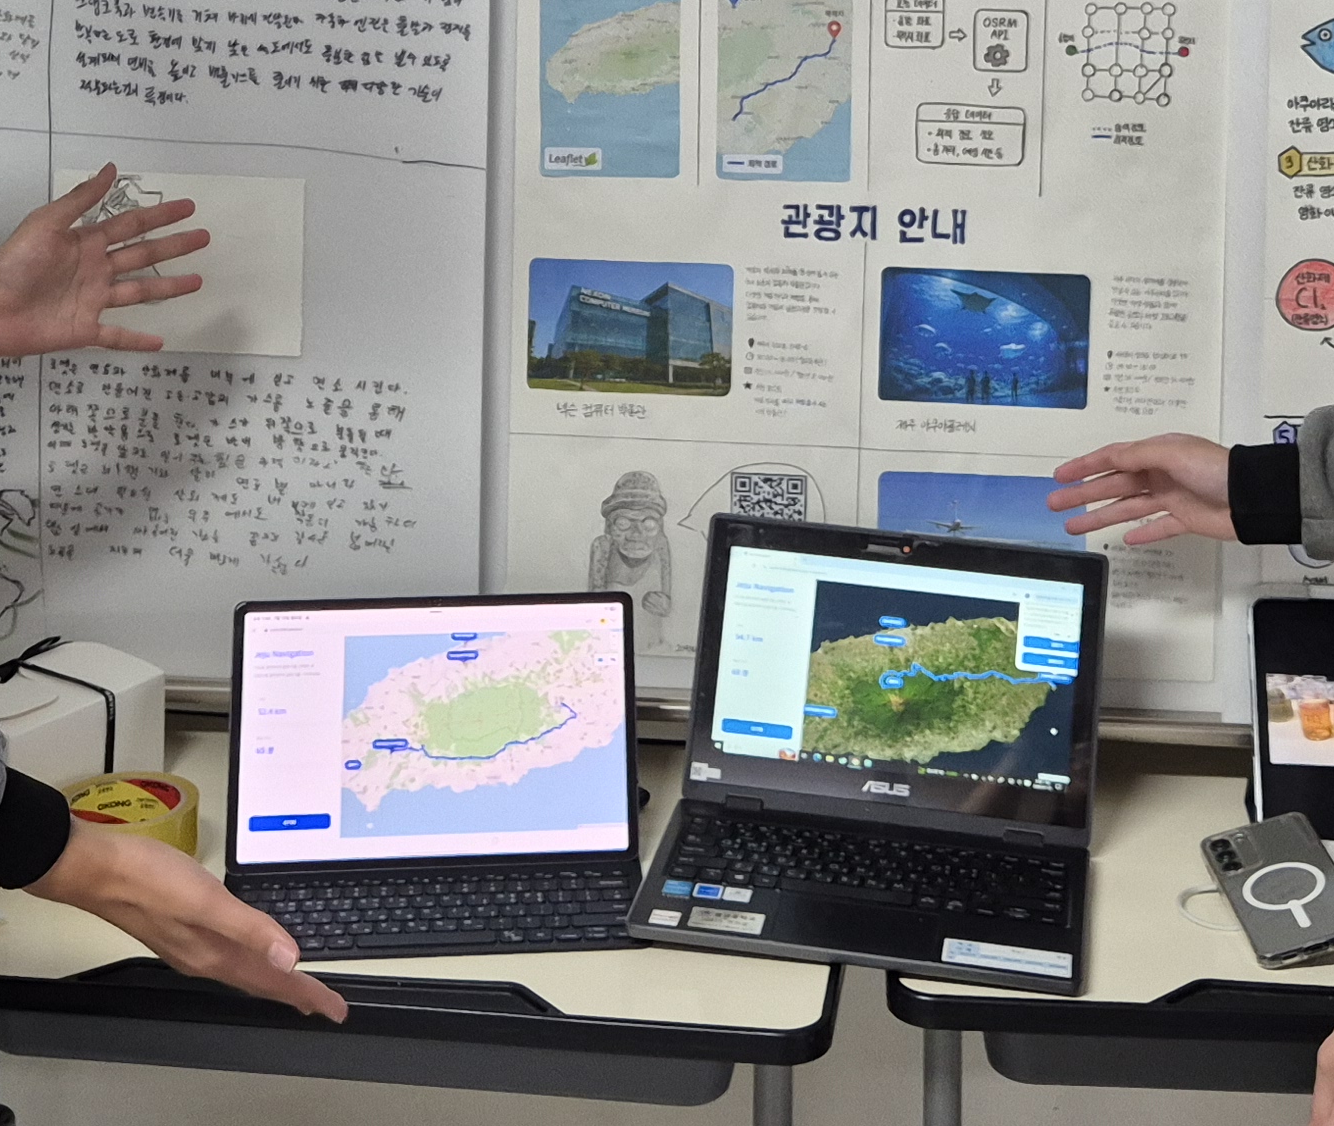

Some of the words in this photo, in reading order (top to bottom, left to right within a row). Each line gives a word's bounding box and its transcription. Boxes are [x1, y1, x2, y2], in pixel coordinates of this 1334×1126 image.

[982, 17, 1018, 29] OSRM
[989, 28, 1010, 42] API
[548, 152, 583, 165] Leaflet
[780, 203, 879, 243] 관광지
[898, 206, 968, 245] 안내
[861, 779, 911, 798] ASUS
